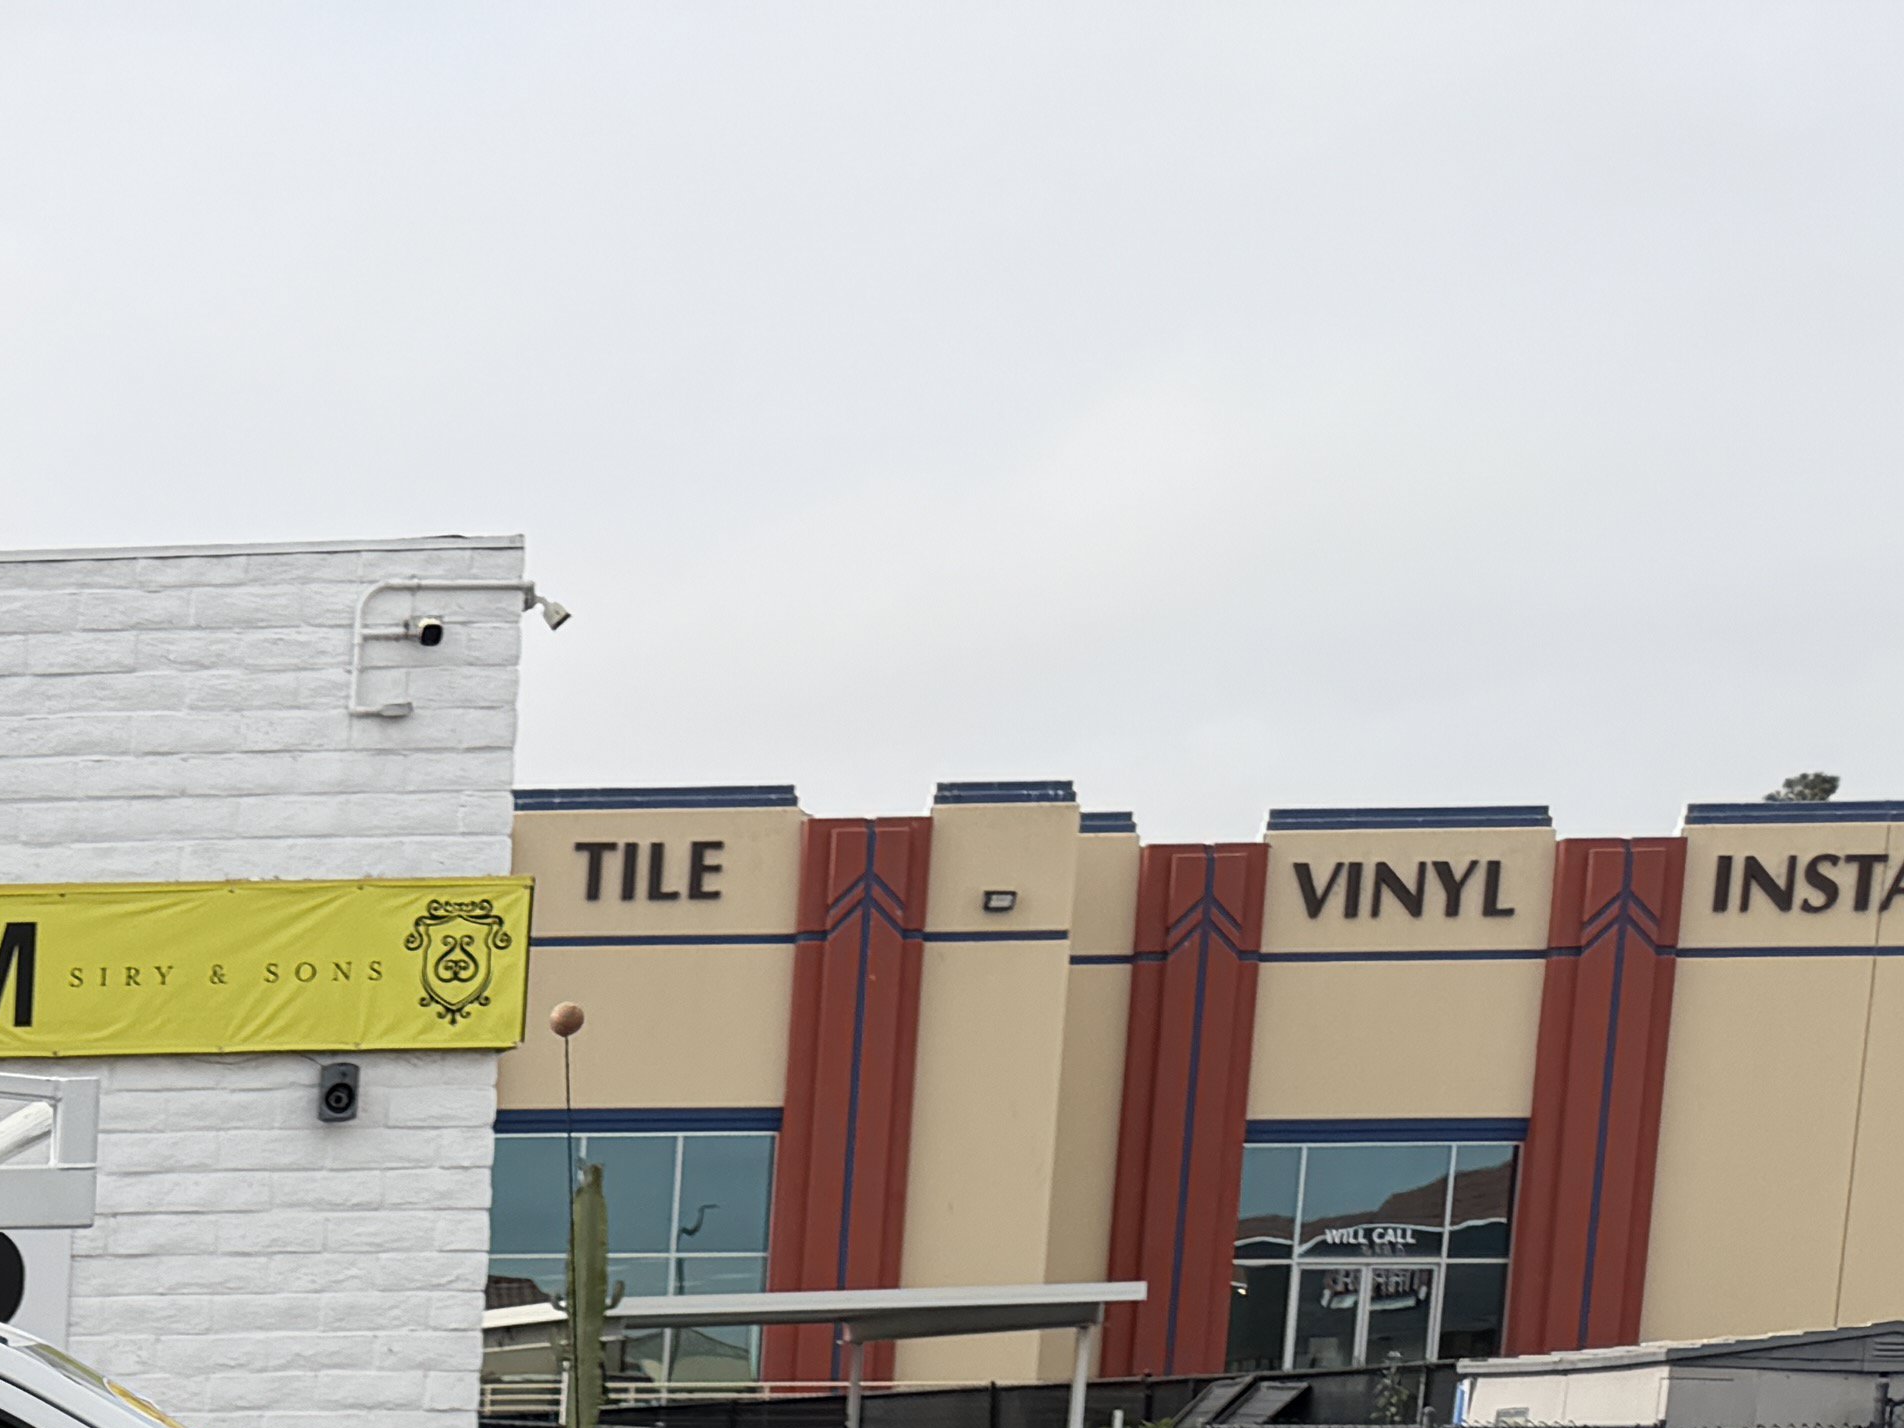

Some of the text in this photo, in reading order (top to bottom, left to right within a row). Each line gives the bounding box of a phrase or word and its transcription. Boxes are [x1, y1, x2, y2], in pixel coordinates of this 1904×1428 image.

[574, 841, 724, 901] TILE
[1293, 860, 1515, 918] VINYL
[68, 960, 384, 988] SIRY & SONS
[1324, 1228, 1417, 1244] WILL CALL
